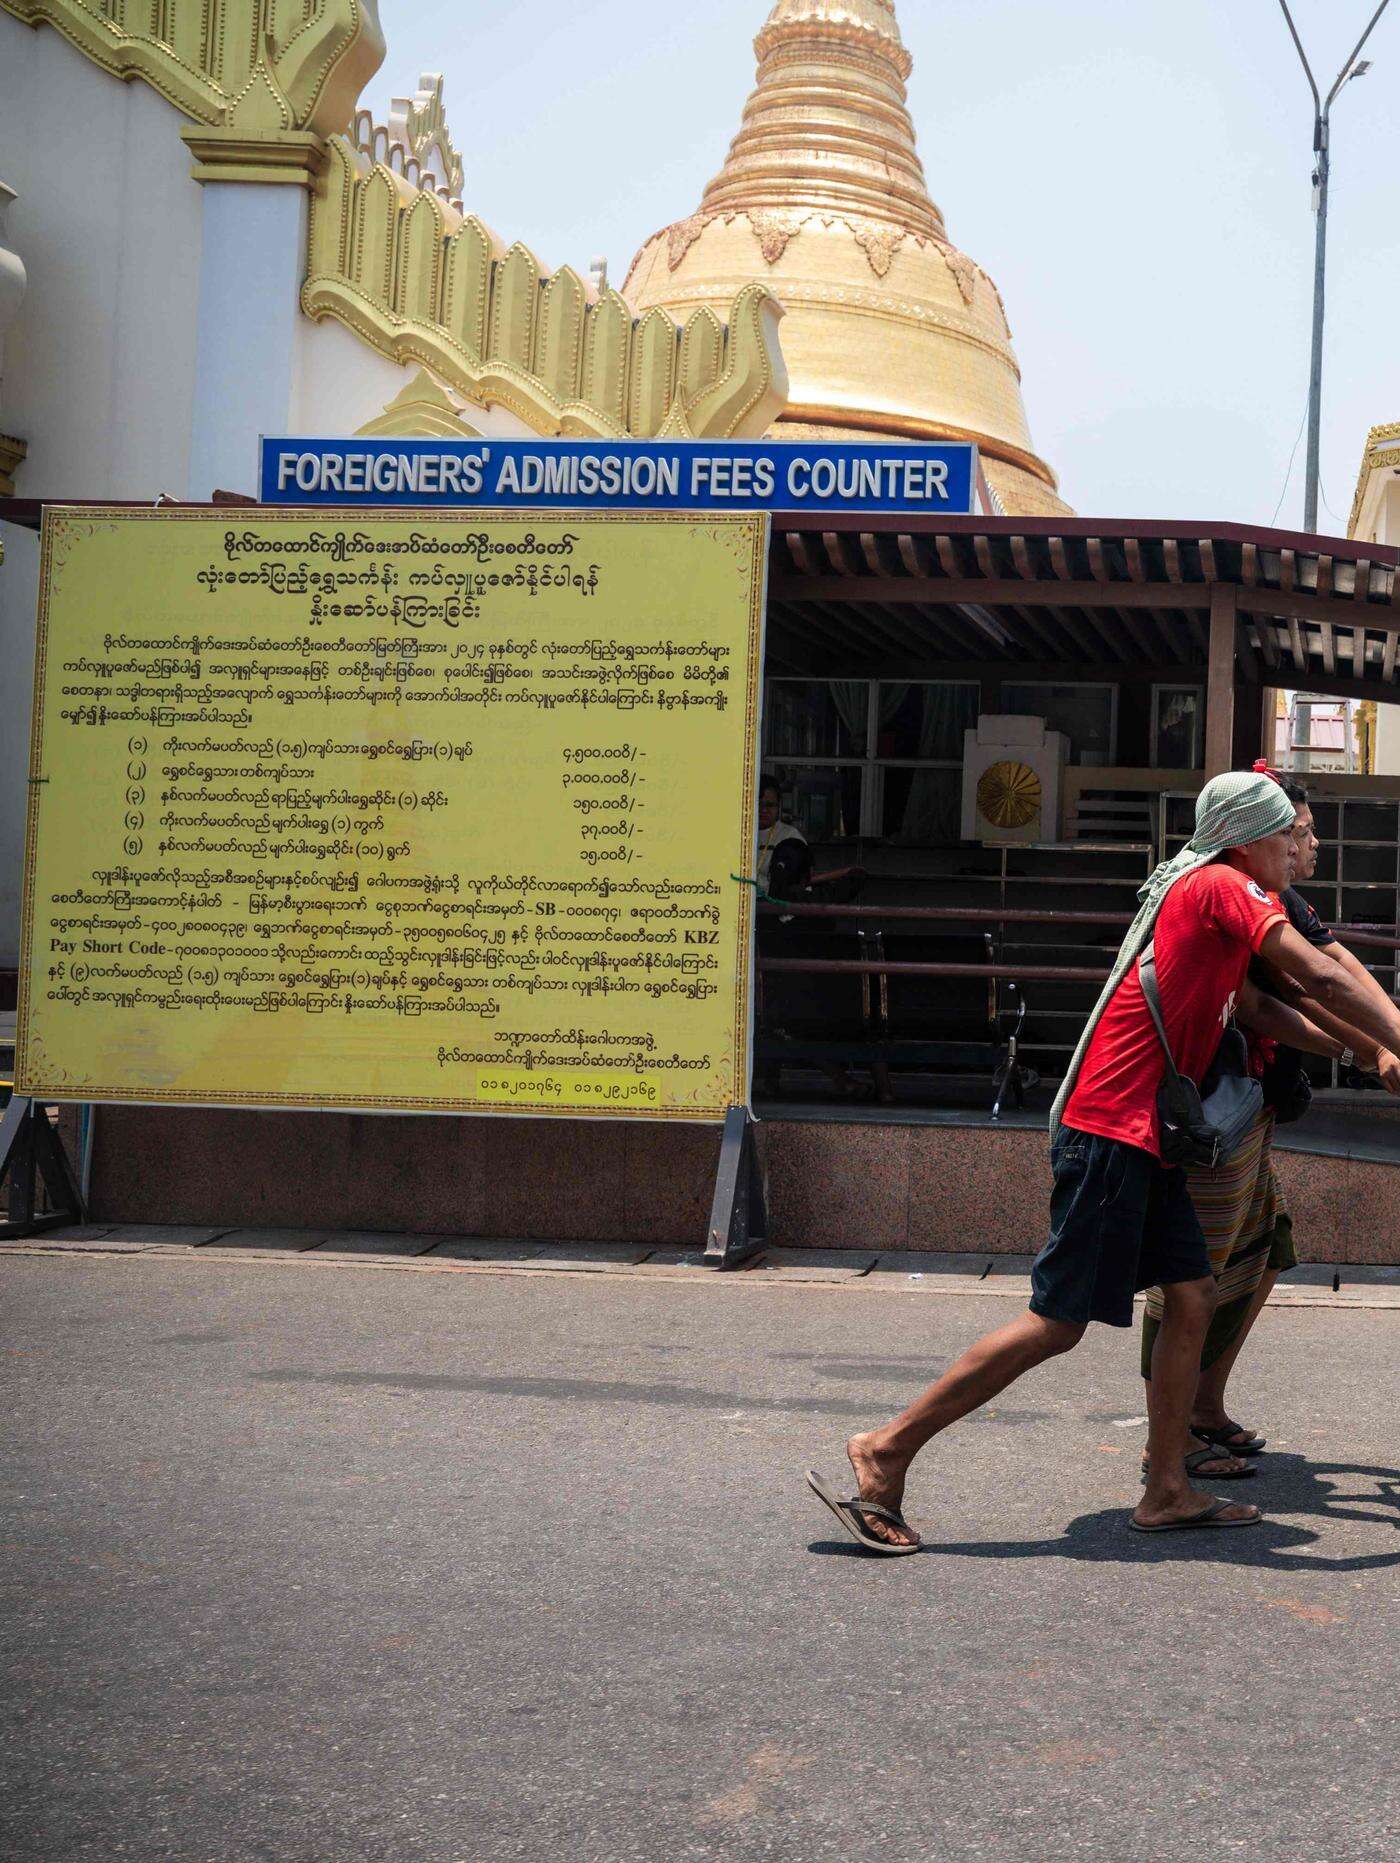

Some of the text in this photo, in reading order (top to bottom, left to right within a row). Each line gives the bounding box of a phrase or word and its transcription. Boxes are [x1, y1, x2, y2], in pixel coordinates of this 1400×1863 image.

[278, 447, 949, 499] FOREIGNERS' ADMISSION FEES COUNTER
[684, 930, 720, 944] KBZ
[50, 938, 77, 955] Pay
[82, 939, 123, 953] Short
